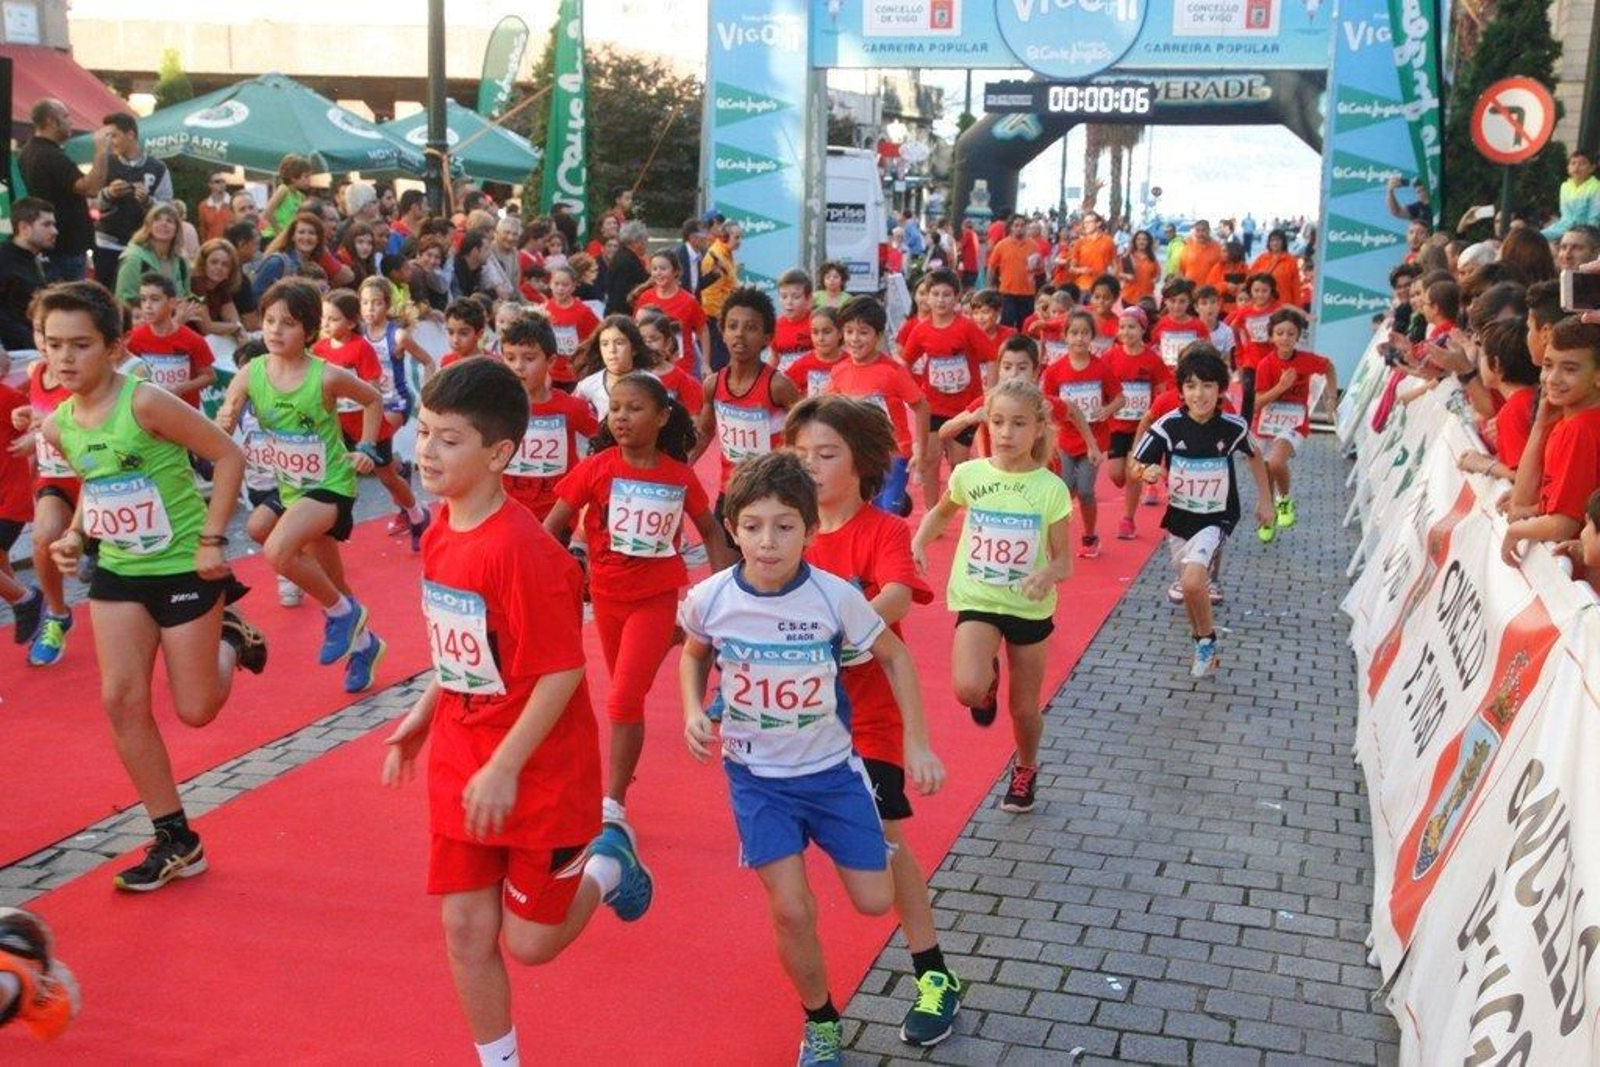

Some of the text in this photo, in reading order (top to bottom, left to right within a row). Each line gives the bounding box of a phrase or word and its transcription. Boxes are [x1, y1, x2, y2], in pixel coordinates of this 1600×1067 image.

[875, 4, 924, 13] CONCELLO
[880, 14, 918, 22] DE VIGO
[1187, 3, 1240, 12] CONCELLO
[1192, 13, 1233, 22] DE VIGO
[862, 42, 989, 53] CARREIRA POPULAR
[1144, 42, 1280, 53] CARREIRA POPULAR
[1049, 86, 1150, 113] 00:00:06
[144, 132, 230, 153] MONDARIZ
[721, 423, 757, 449] 2111
[967, 481, 1001, 501] WANT
[1174, 476, 1222, 498] 2177
[87, 501, 154, 536] 2097
[614, 506, 675, 537] 2198
[971, 535, 1029, 565] 2182
[732, 673, 824, 711] 2162
